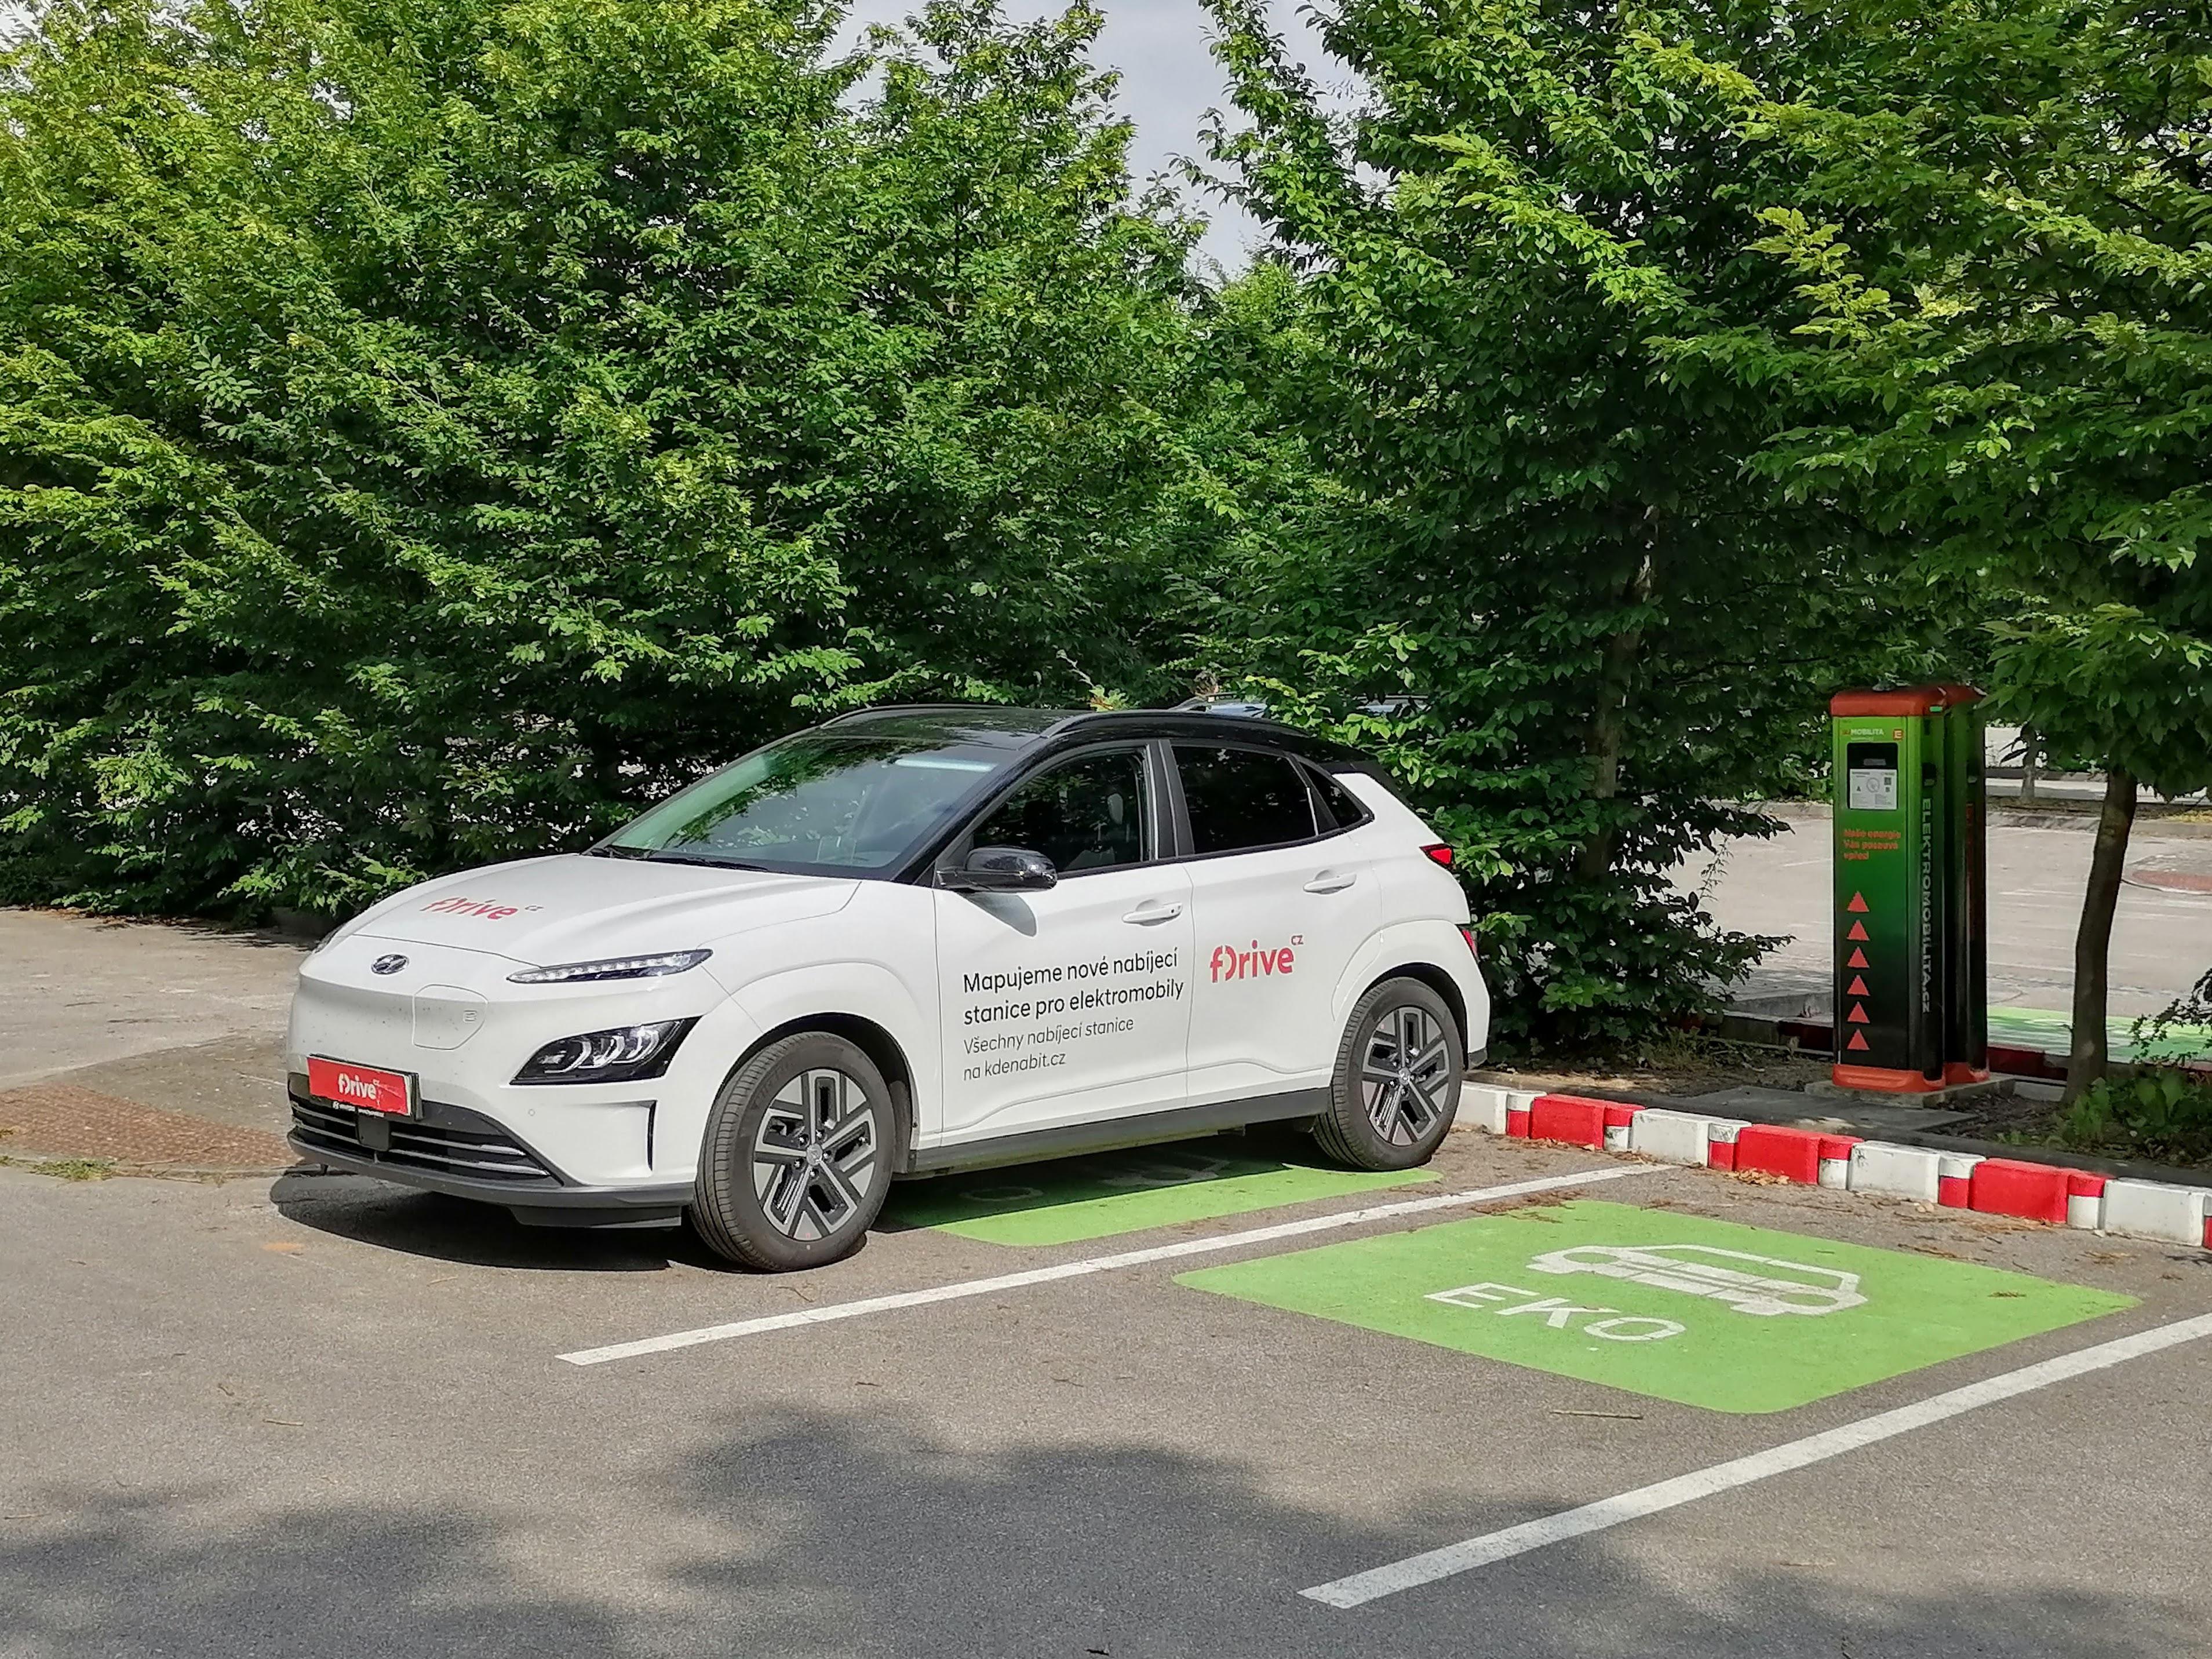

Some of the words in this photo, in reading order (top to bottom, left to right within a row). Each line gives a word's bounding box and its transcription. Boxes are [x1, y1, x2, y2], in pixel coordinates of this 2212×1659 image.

[1921, 797, 1932, 1014] ELEKTROMOBILITA.CZ
[963, 966, 1062, 994] Mapujeme
[1067, 956, 1109, 980] nové
[1113, 947, 1178, 974] nabíjecí
[964, 1000, 1030, 1025] stanice
[1036, 998, 1065, 1020] pro
[1070, 978, 1184, 1011] elektromobily
[963, 1035, 1024, 1055] Všechny
[1085, 1017, 1134, 1036] stanice
[964, 1067, 981, 1081] na
[985, 1052, 1066, 1076] kdenabit.cz
[1423, 1282, 1687, 1342] EKO
